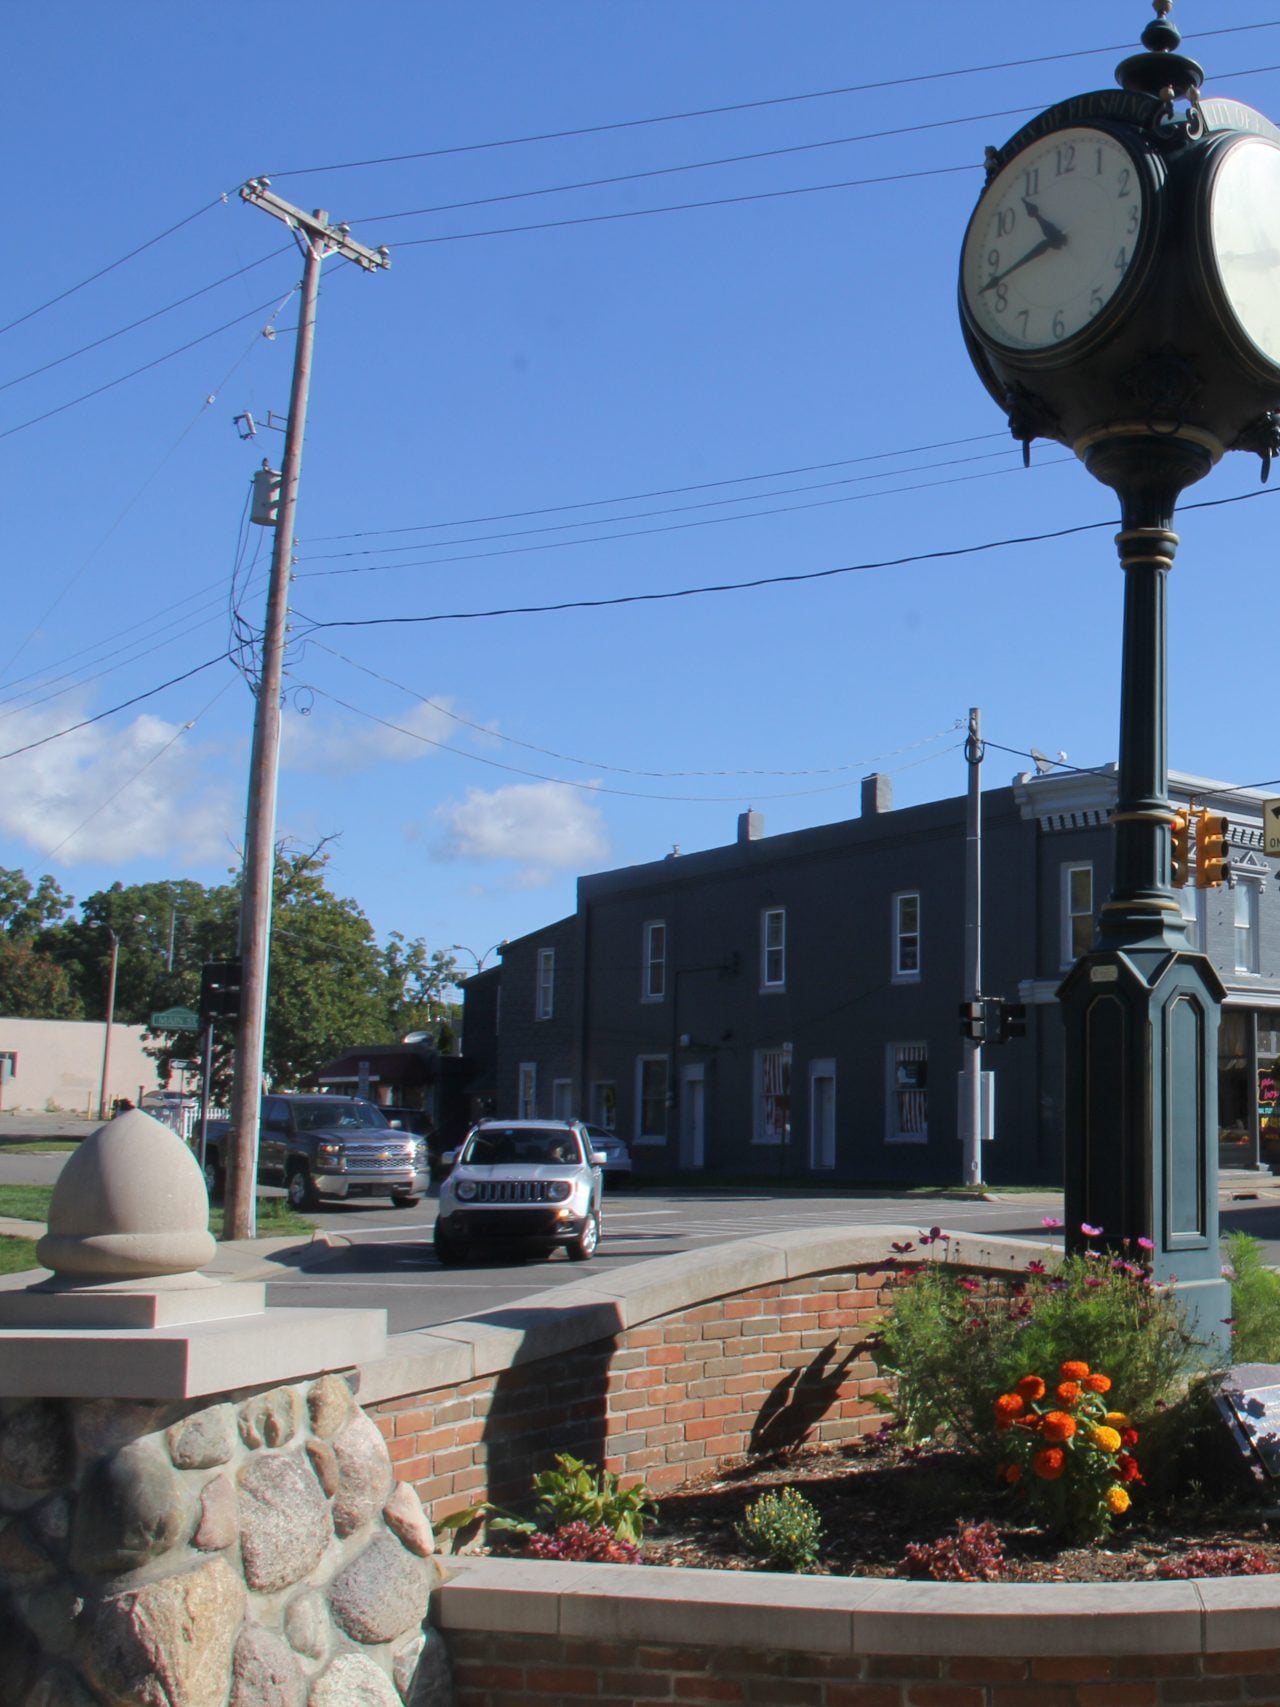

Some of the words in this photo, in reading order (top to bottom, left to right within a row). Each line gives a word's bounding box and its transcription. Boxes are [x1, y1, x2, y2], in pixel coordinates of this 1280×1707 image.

[1068, 91, 1153, 121] FLUSHING
[1202, 103, 1231, 126] CITY
[1055, 145, 1076, 176] 12
[1096, 147, 1104, 176] 1
[1023, 168, 1040, 197] 11
[1118, 168, 1131, 198] 2
[995, 207, 1016, 238] 10
[1127, 205, 1138, 235] 3
[988, 249, 1000, 277] 9
[1115, 246, 1129, 277] 4
[995, 282, 1008, 314] 8
[1089, 286, 1104, 317] 5
[1016, 309, 1030, 339] 7
[1052, 310, 1065, 340] 6
[158, 1017, 183, 1025] MAIN
